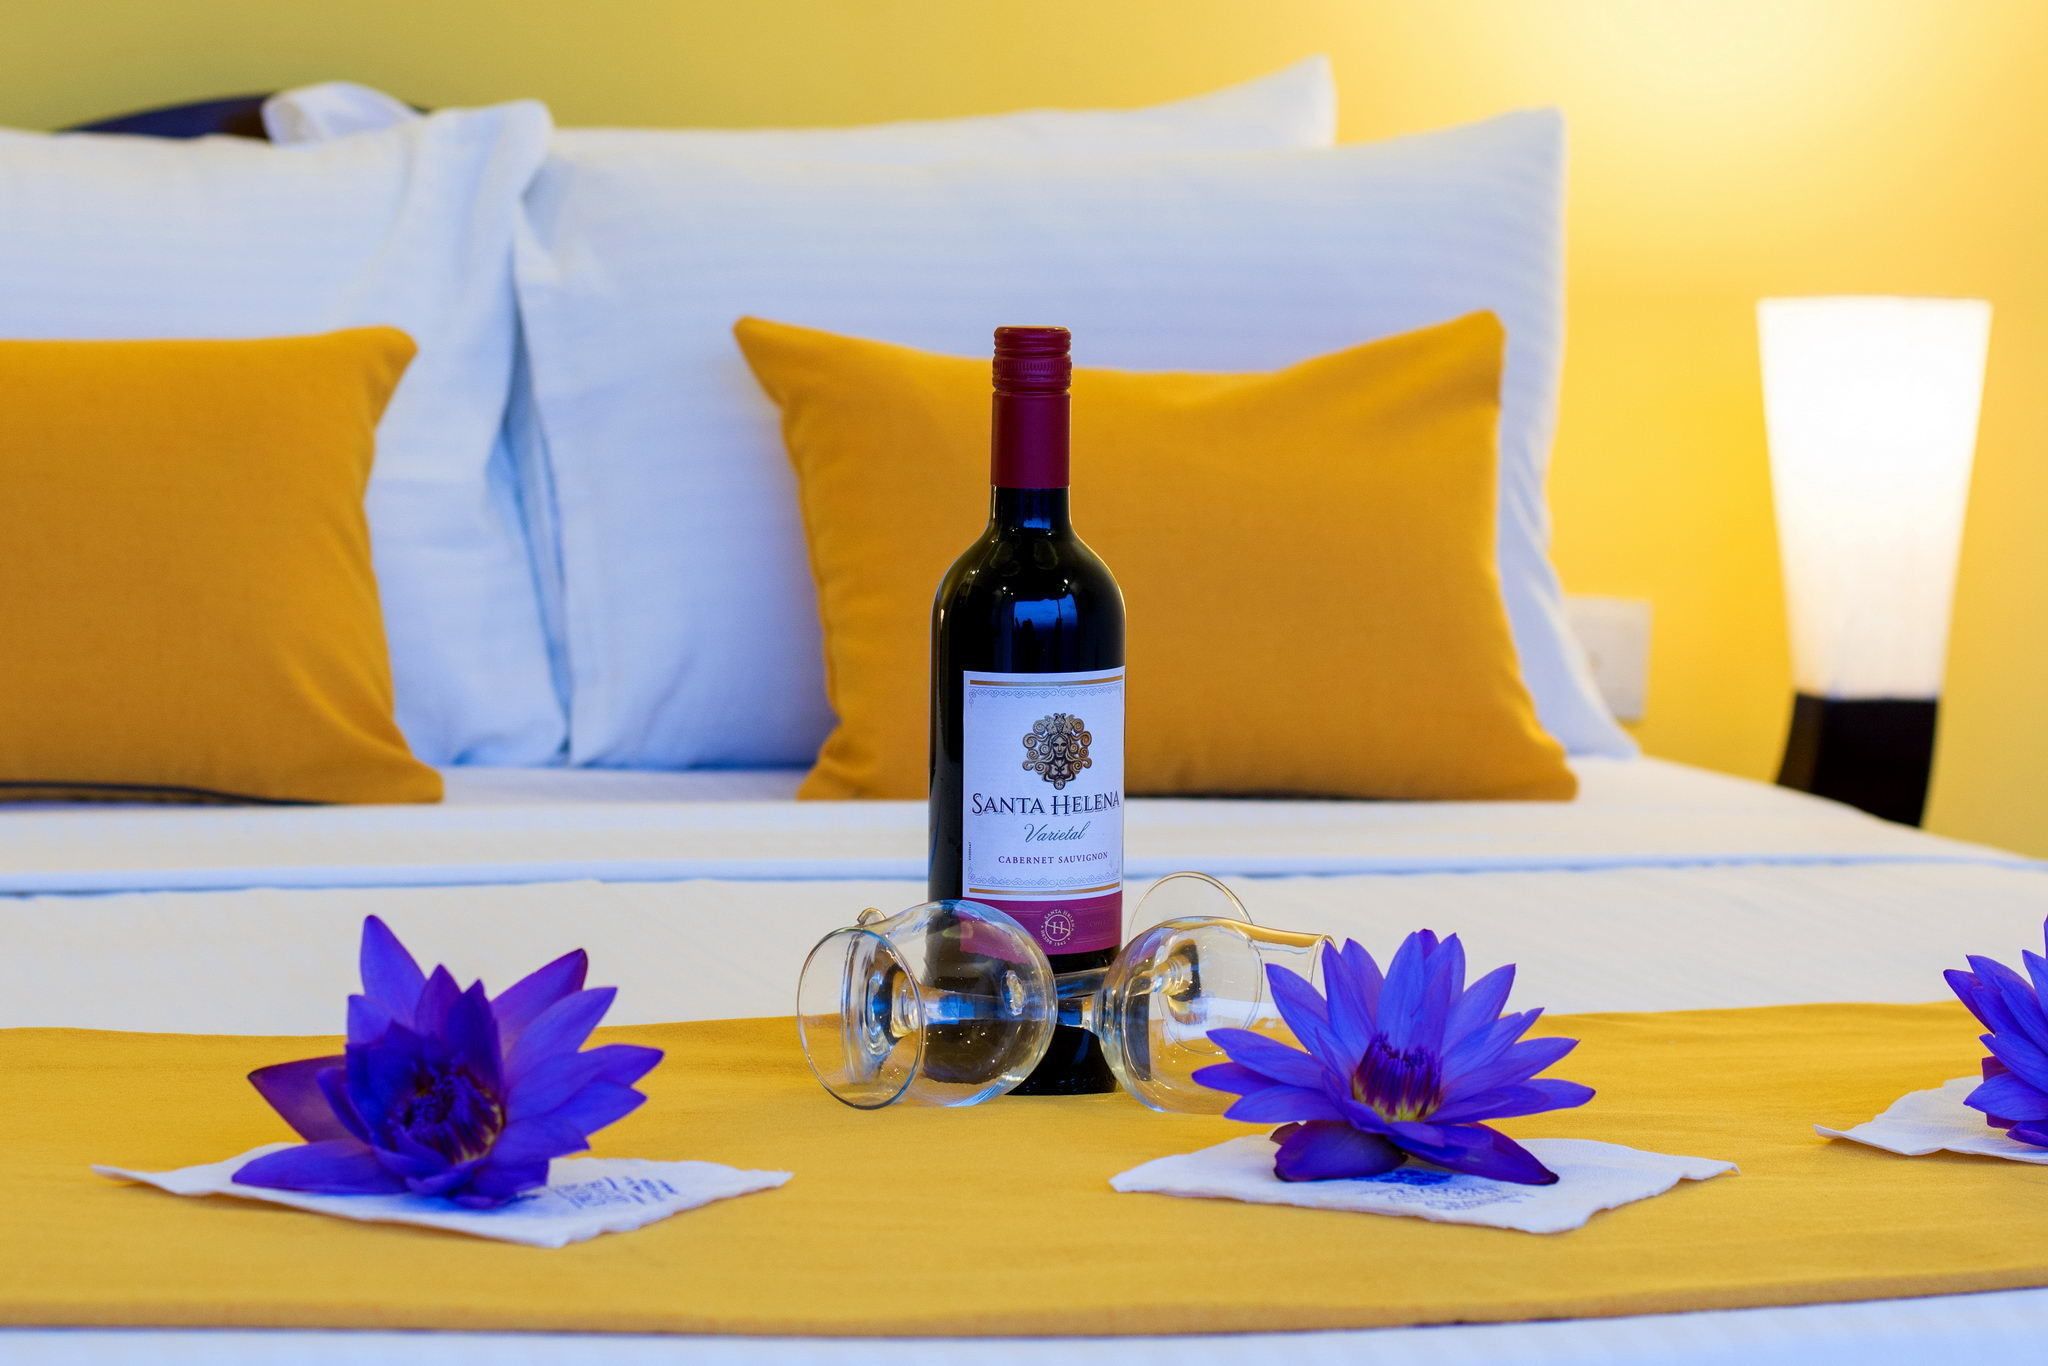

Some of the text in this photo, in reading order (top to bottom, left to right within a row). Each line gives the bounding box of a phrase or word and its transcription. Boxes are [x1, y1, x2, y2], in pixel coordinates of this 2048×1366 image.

[971, 790, 1120, 816] SANTA HELENA
[1024, 820, 1091, 843] Varietal
[998, 851, 1108, 864] CABERNET SAUVIGNON
